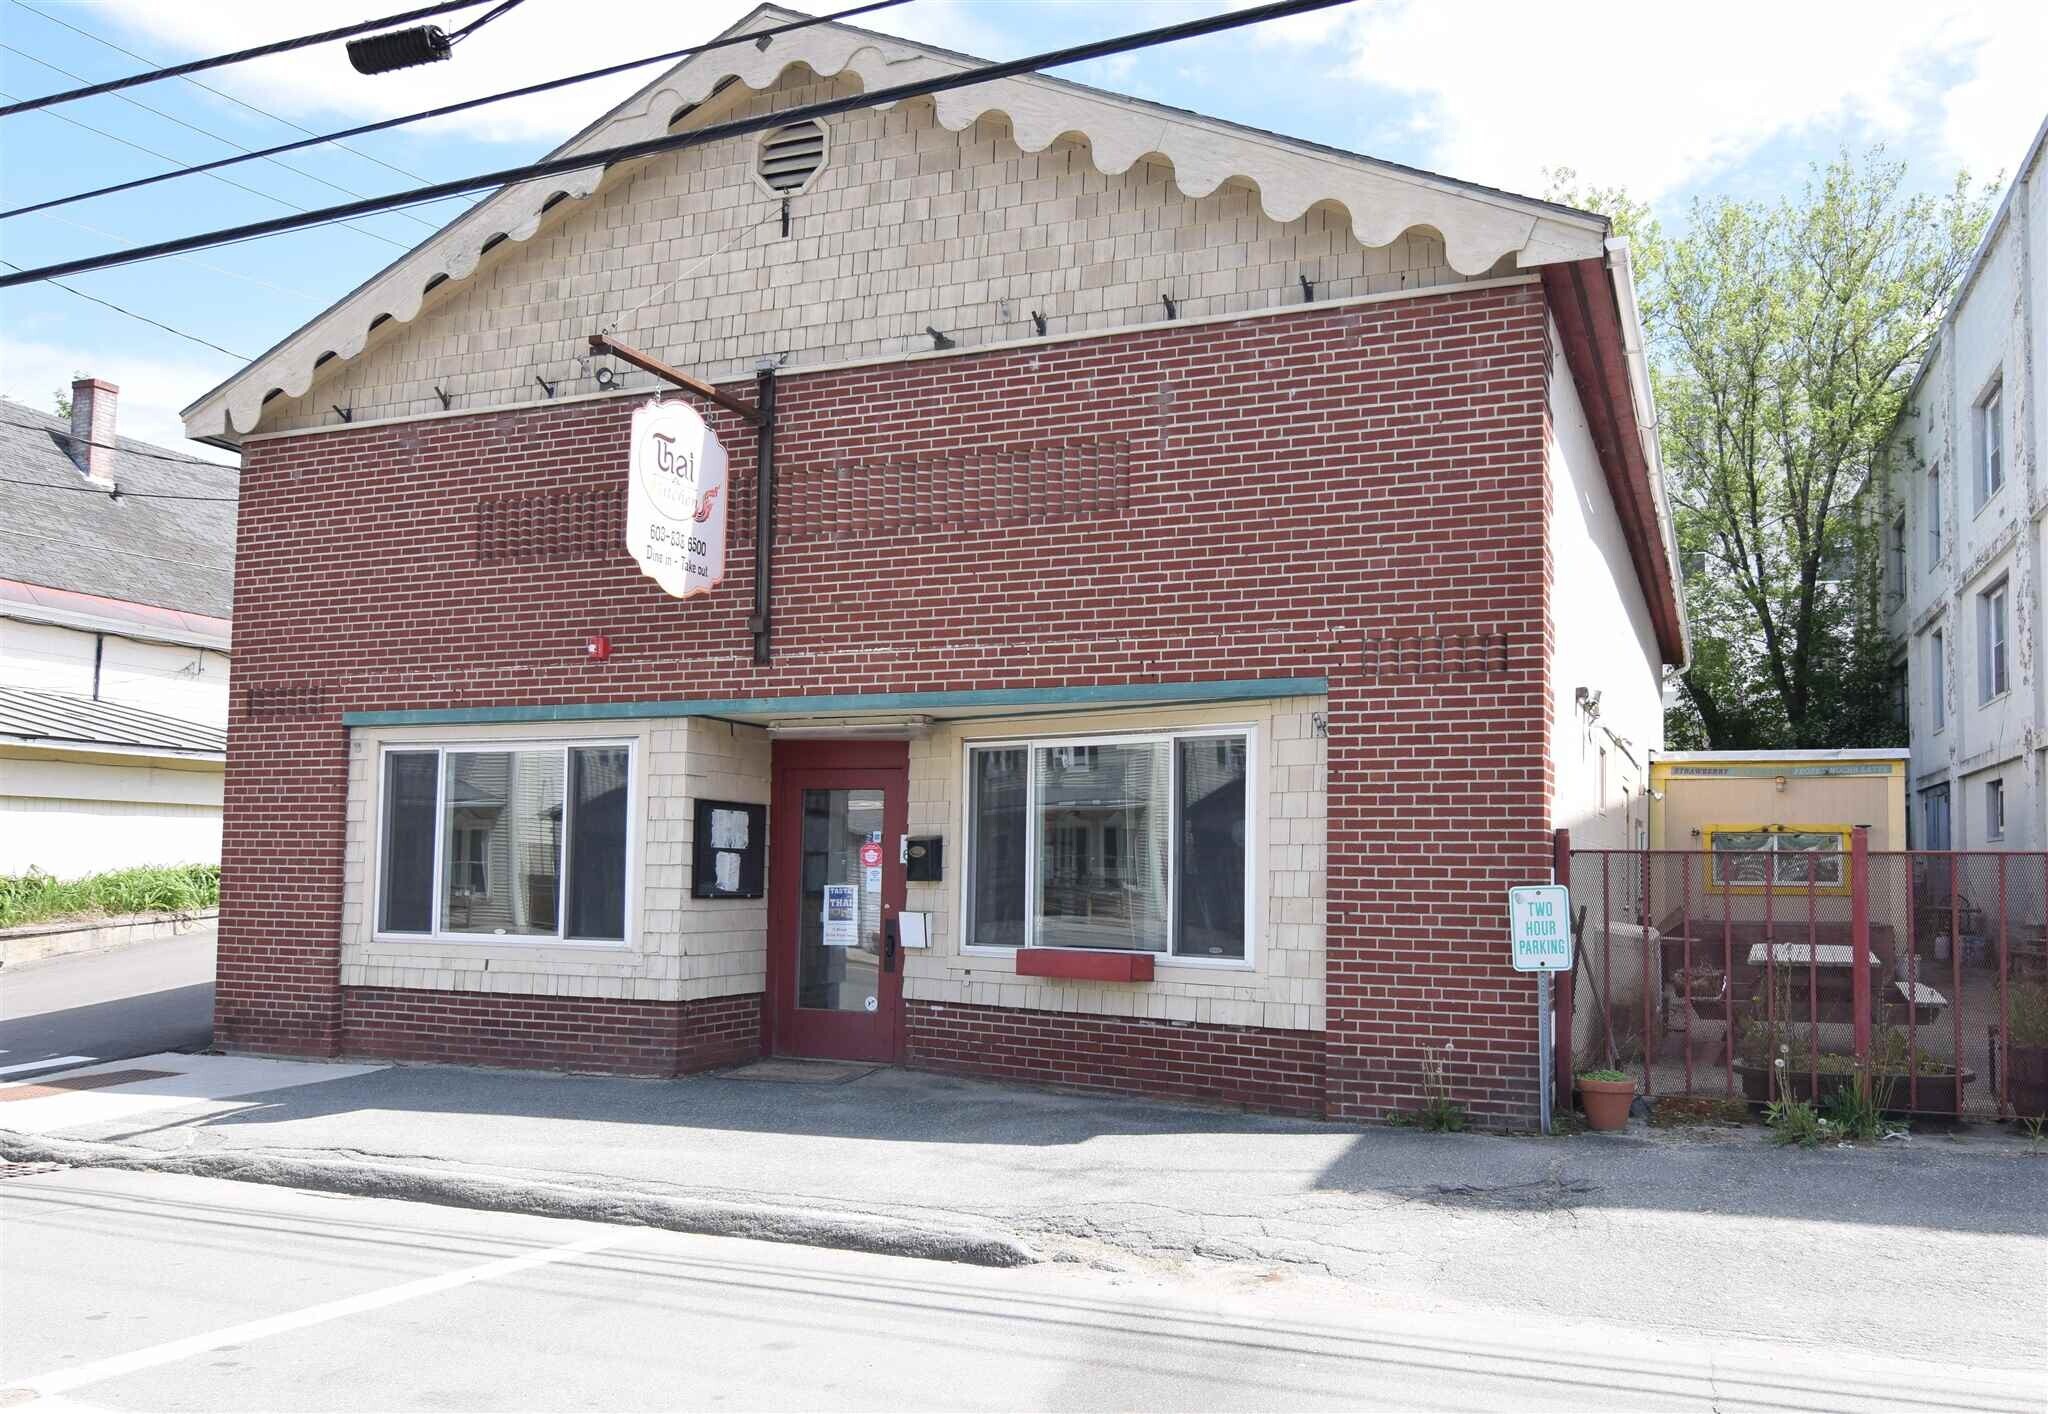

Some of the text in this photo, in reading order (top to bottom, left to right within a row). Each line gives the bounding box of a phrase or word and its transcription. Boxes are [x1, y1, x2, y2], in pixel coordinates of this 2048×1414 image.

[653, 432, 694, 483] Thai
[645, 544, 664, 564] Dine
[681, 555, 697, 574] Take
[697, 564, 709, 578] out
[1527, 901, 1553, 917] TWO
[1525, 920, 1557, 937] HOUR
[1519, 938, 1566, 955] PARKING
